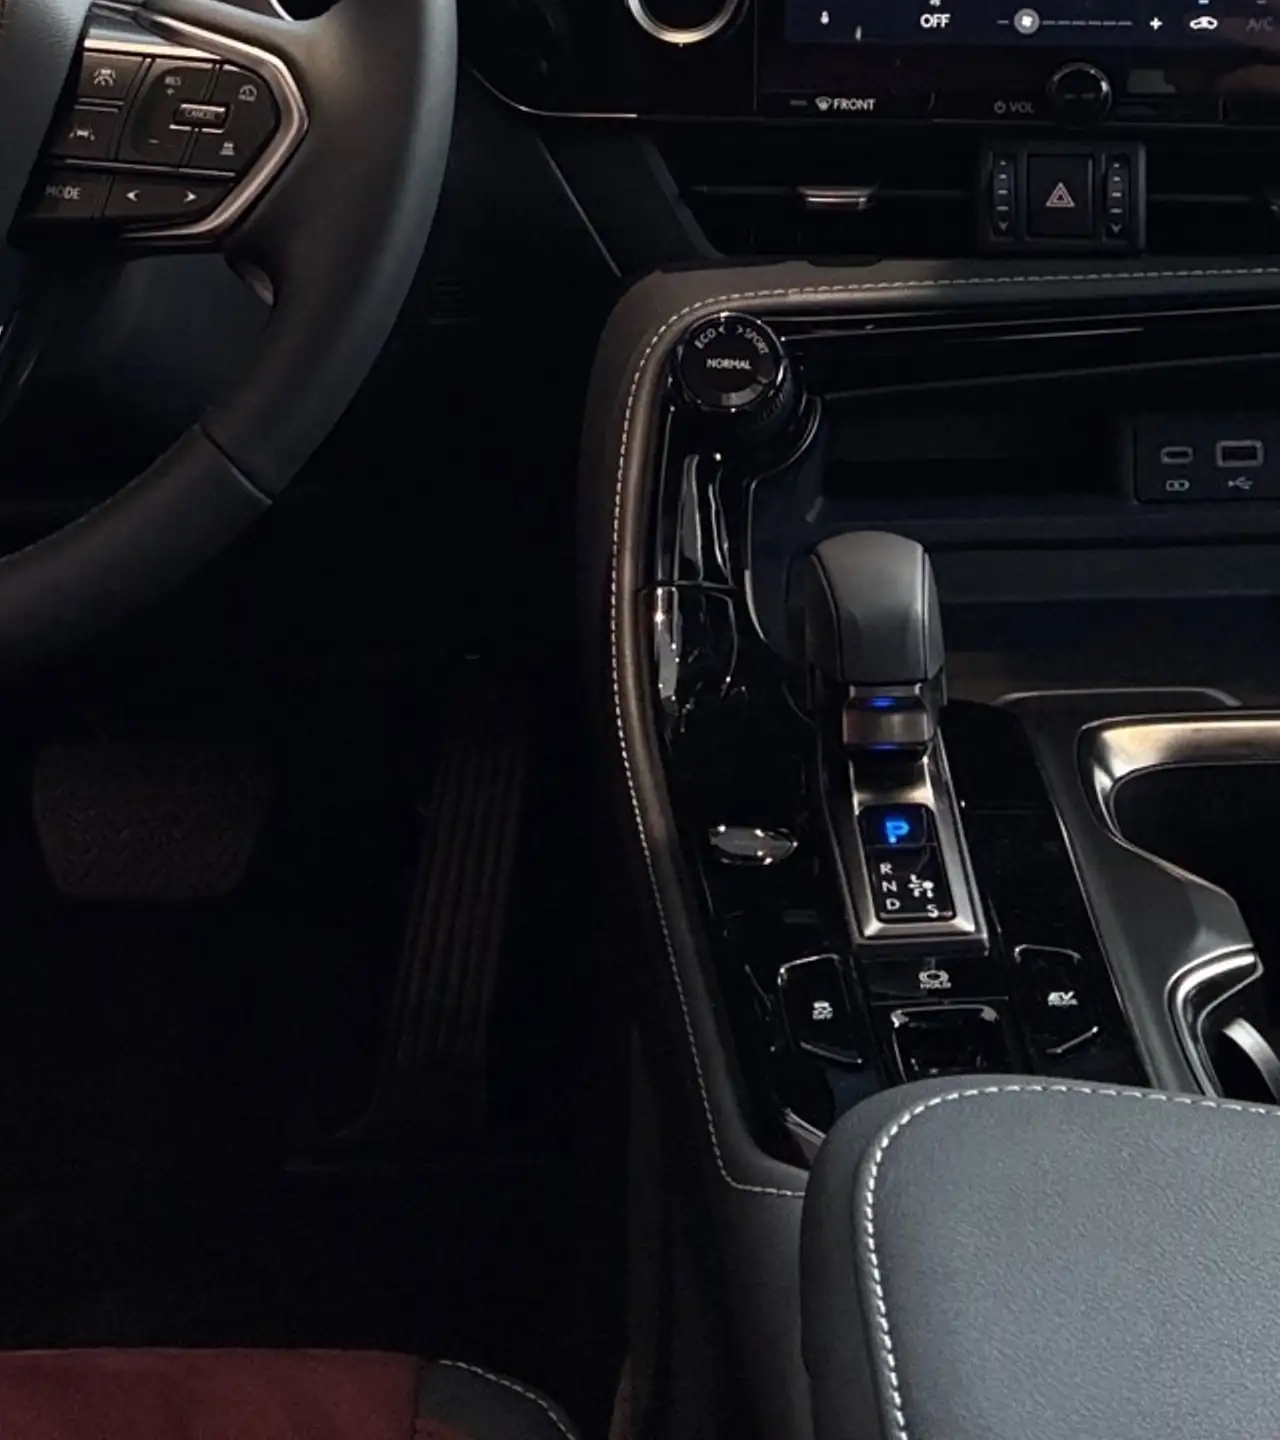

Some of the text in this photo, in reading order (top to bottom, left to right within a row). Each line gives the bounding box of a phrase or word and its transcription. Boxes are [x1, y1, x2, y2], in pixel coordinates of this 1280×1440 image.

[919, 13, 952, 29] OFF
[1246, 17, 1275, 33] A/C
[832, 97, 877, 112] FRONT
[1009, 100, 1035, 114] VOL
[43, 183, 82, 200] MODE
[705, 358, 753, 370] NORMAL
[884, 818, 911, 845] P
[879, 861, 893, 875] R
[881, 879, 899, 893] N
[885, 897, 901, 911] D
[925, 903, 940, 919] S
